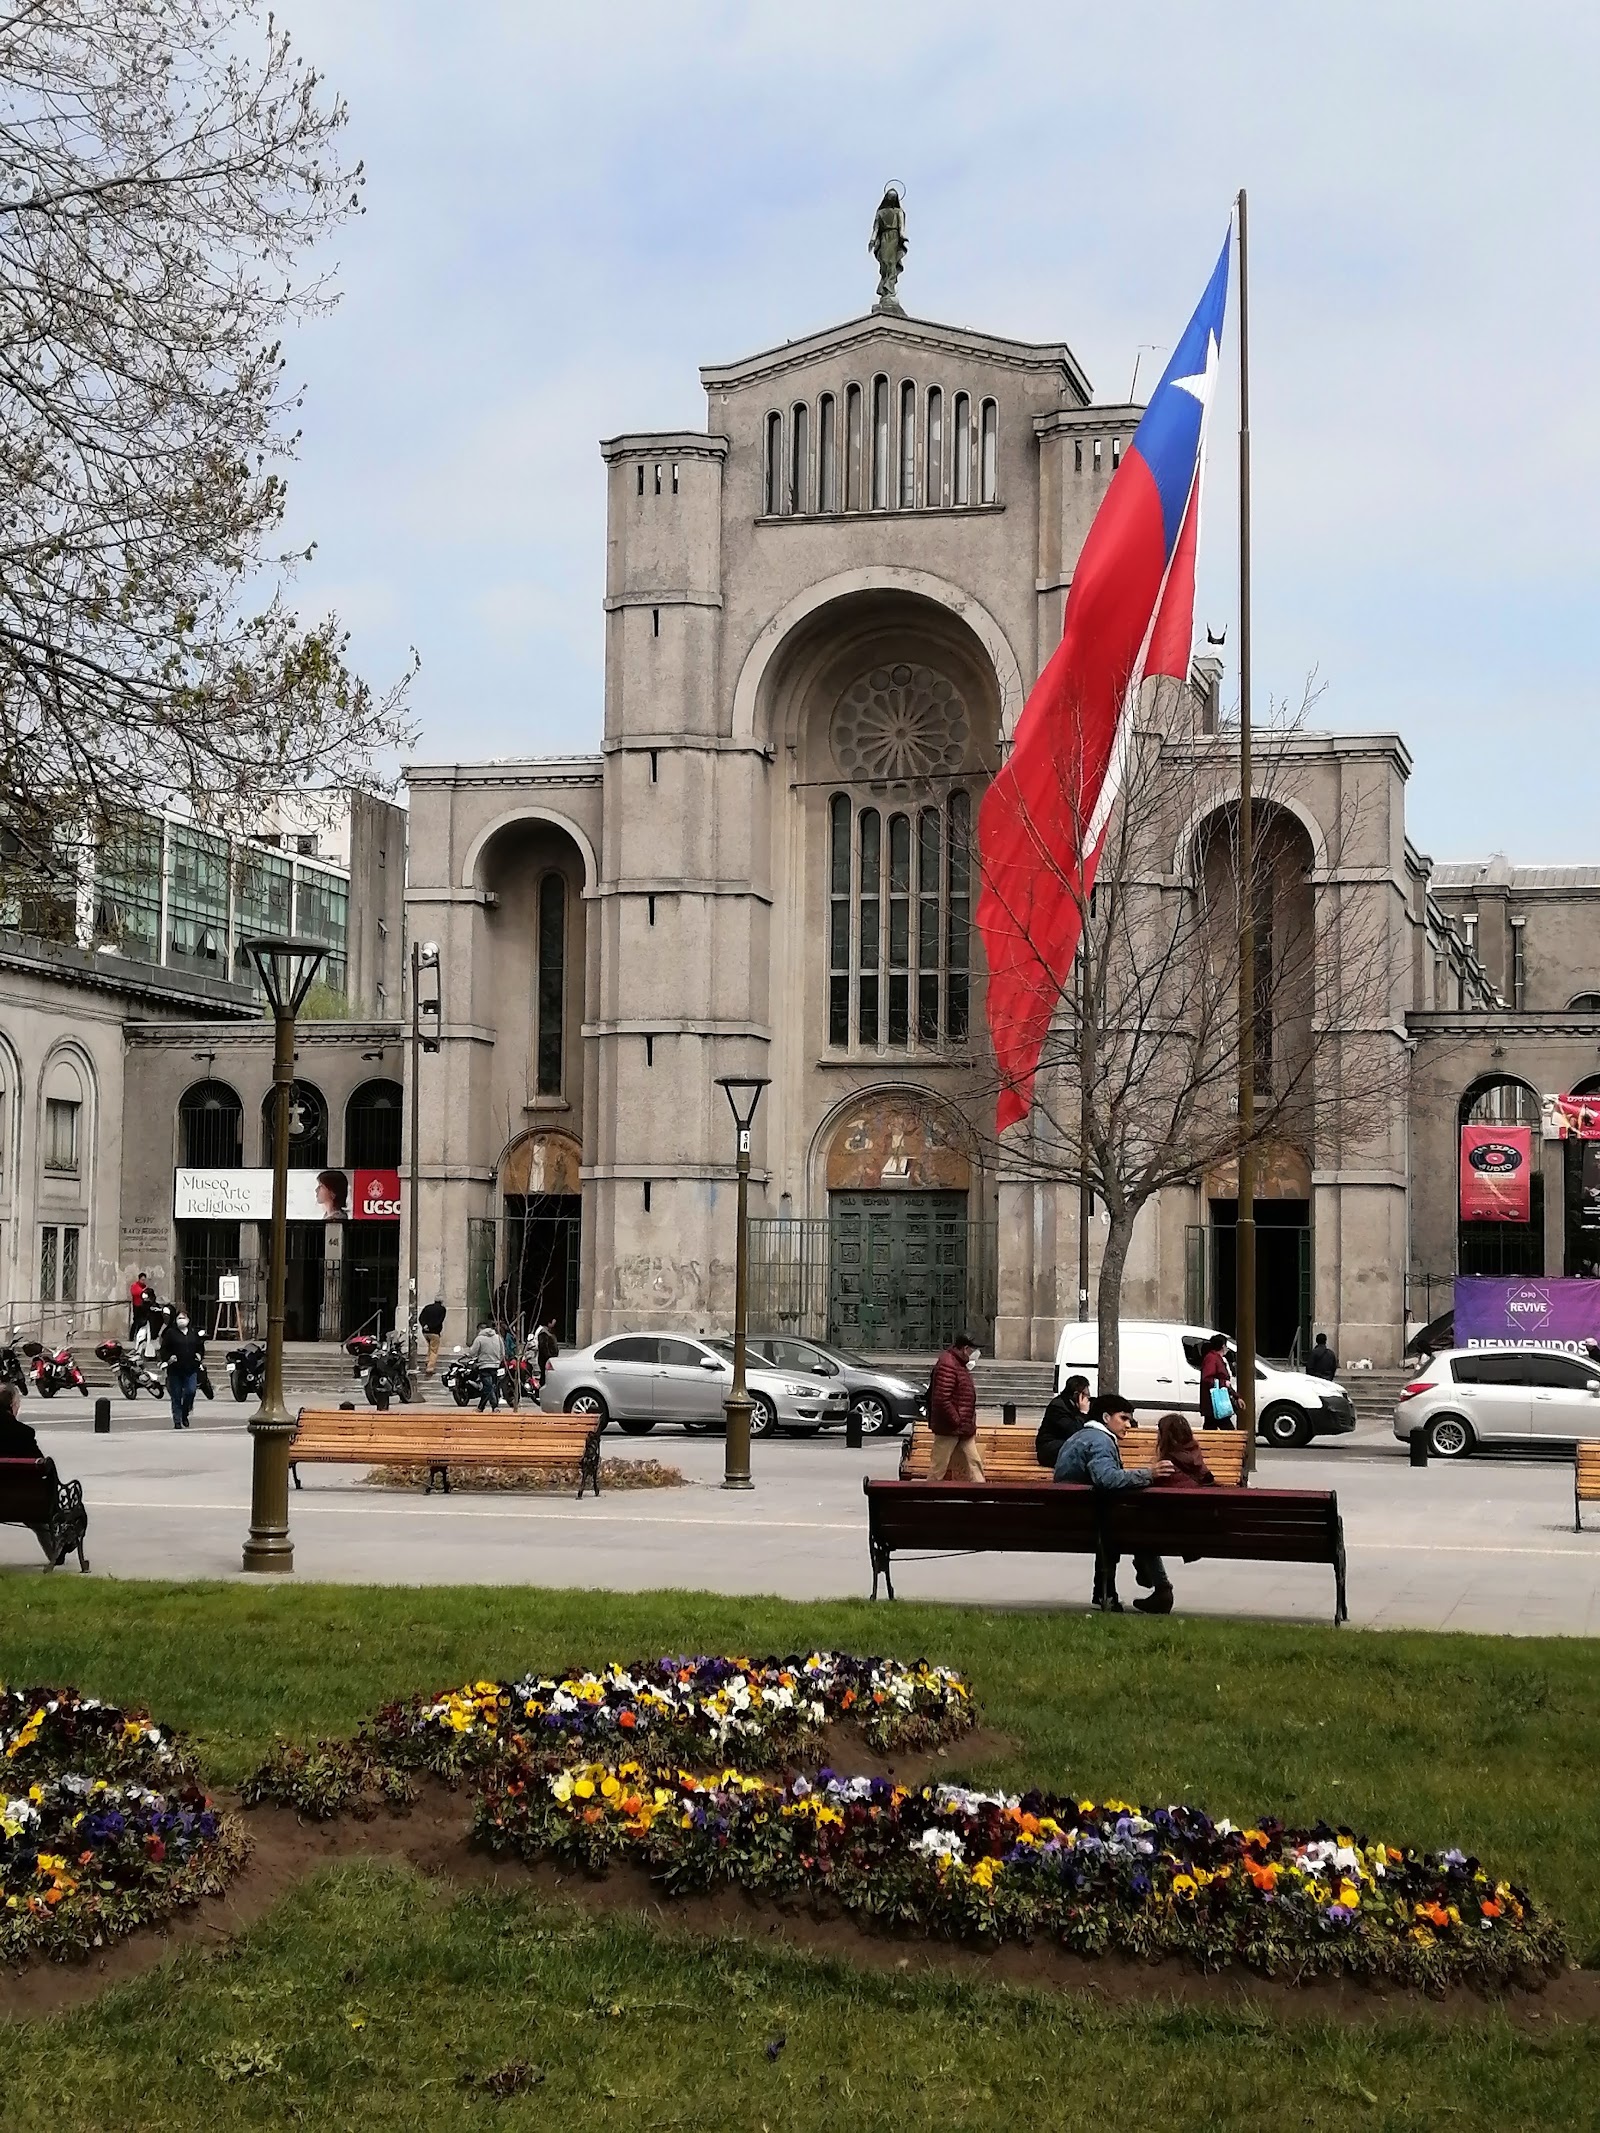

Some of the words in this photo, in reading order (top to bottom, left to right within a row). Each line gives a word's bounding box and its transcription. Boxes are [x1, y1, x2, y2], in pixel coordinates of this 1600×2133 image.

[1479, 1163, 1513, 1172] AUDIO
[182, 1176, 229, 1190] Museo
[188, 1198, 250, 1217] Religioso
[1510, 1302, 1547, 1313] REVIVE
[1467, 1338, 1588, 1356] BIENVENIDOS
